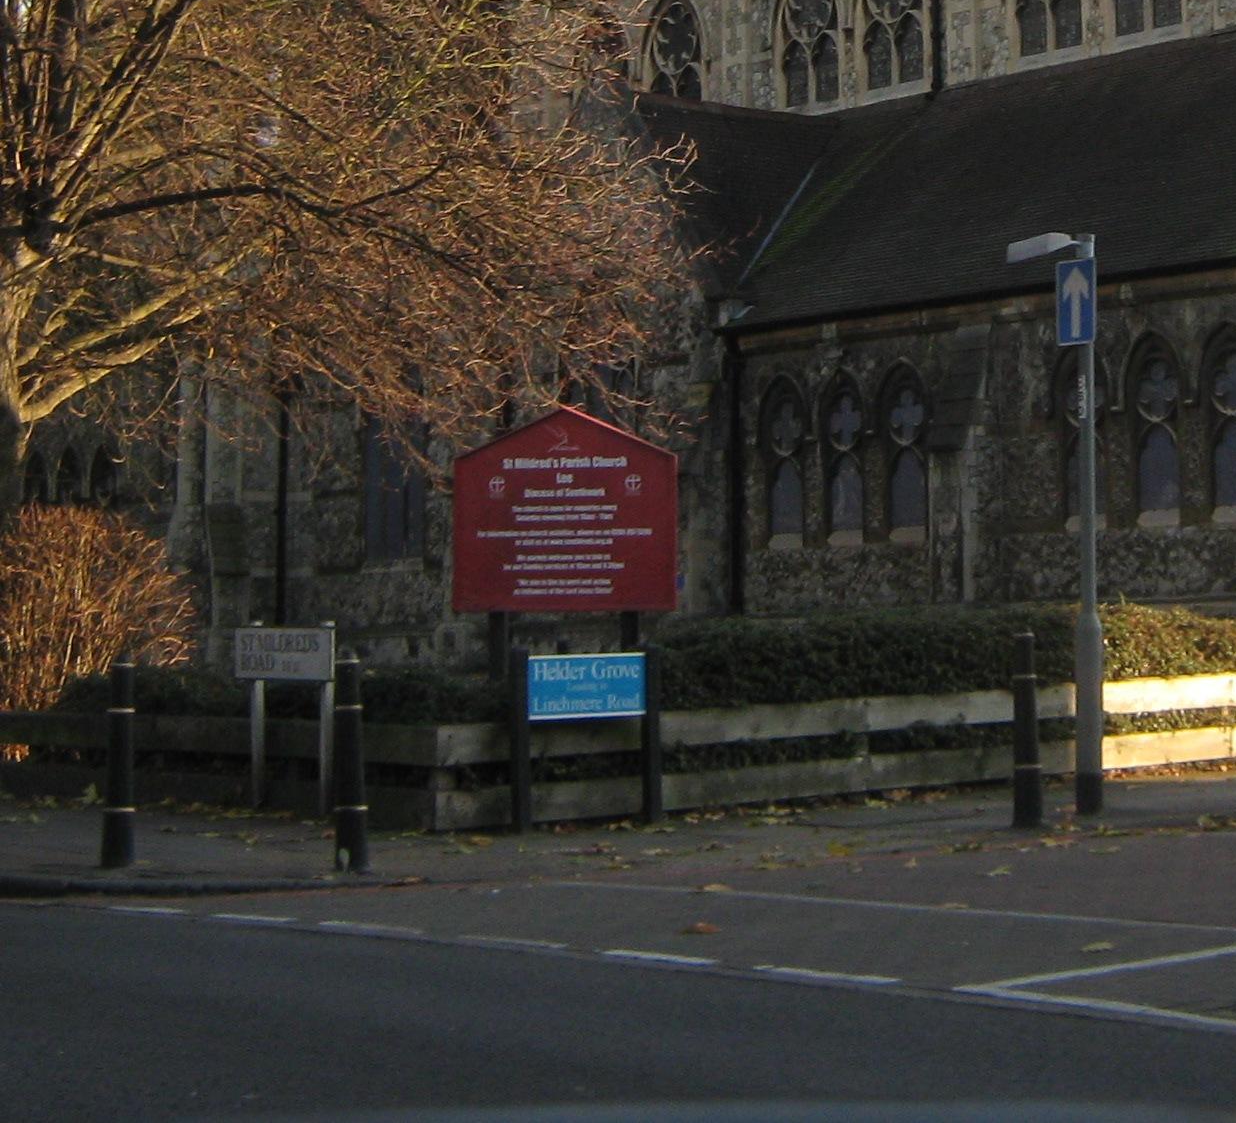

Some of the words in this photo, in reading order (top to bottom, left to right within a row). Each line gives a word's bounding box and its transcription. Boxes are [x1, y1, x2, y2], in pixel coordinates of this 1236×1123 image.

[502, 458, 513, 469] St
[560, 456, 591, 468] Parish
[592, 455, 628, 468] Church
[556, 472, 574, 484] Lee
[556, 487, 565, 497] of
[240, 653, 275, 672] ROAD
[534, 661, 586, 681] Helder
[591, 659, 640, 680] Grove
[534, 696, 603, 712] Linchmere
[607, 693, 640, 710] Road
